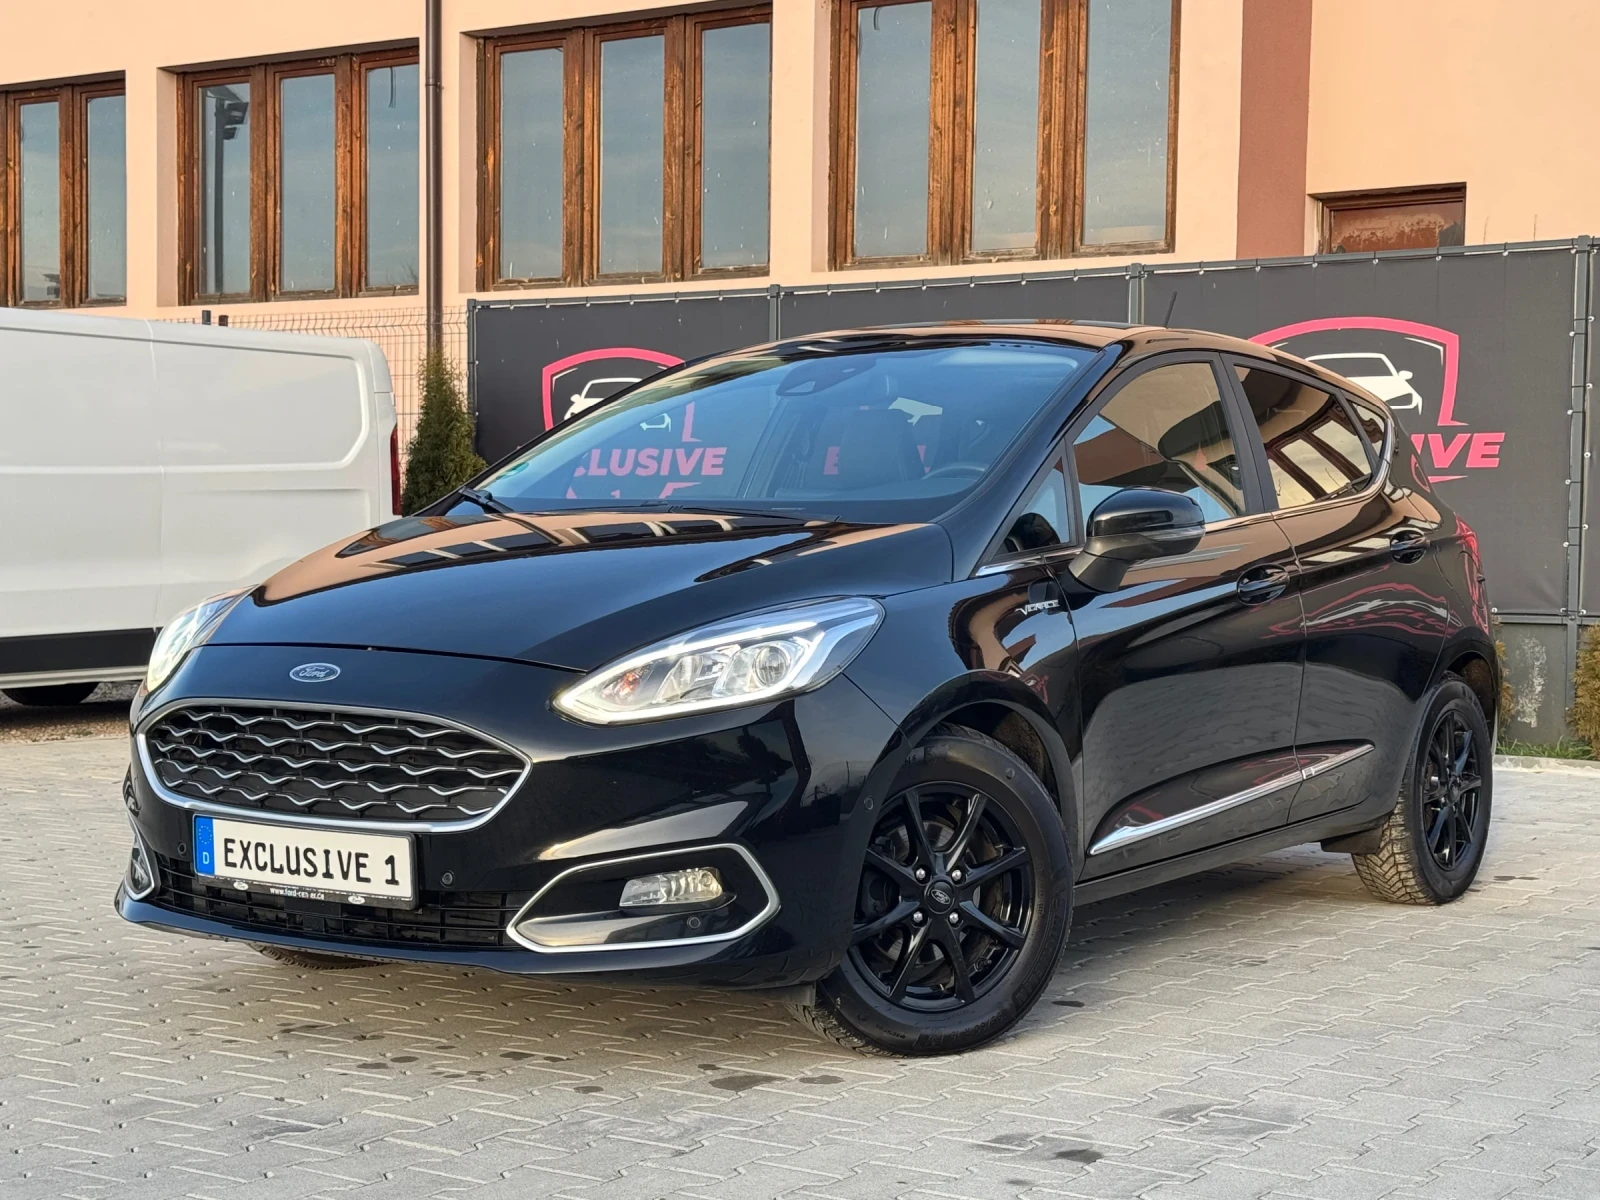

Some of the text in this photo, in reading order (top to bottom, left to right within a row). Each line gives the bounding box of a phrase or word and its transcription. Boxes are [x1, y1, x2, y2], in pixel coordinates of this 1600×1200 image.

[297, 665, 333, 679] Ford
[202, 851, 210, 865] D
[224, 838, 400, 886] EXCLUSIVE 1
